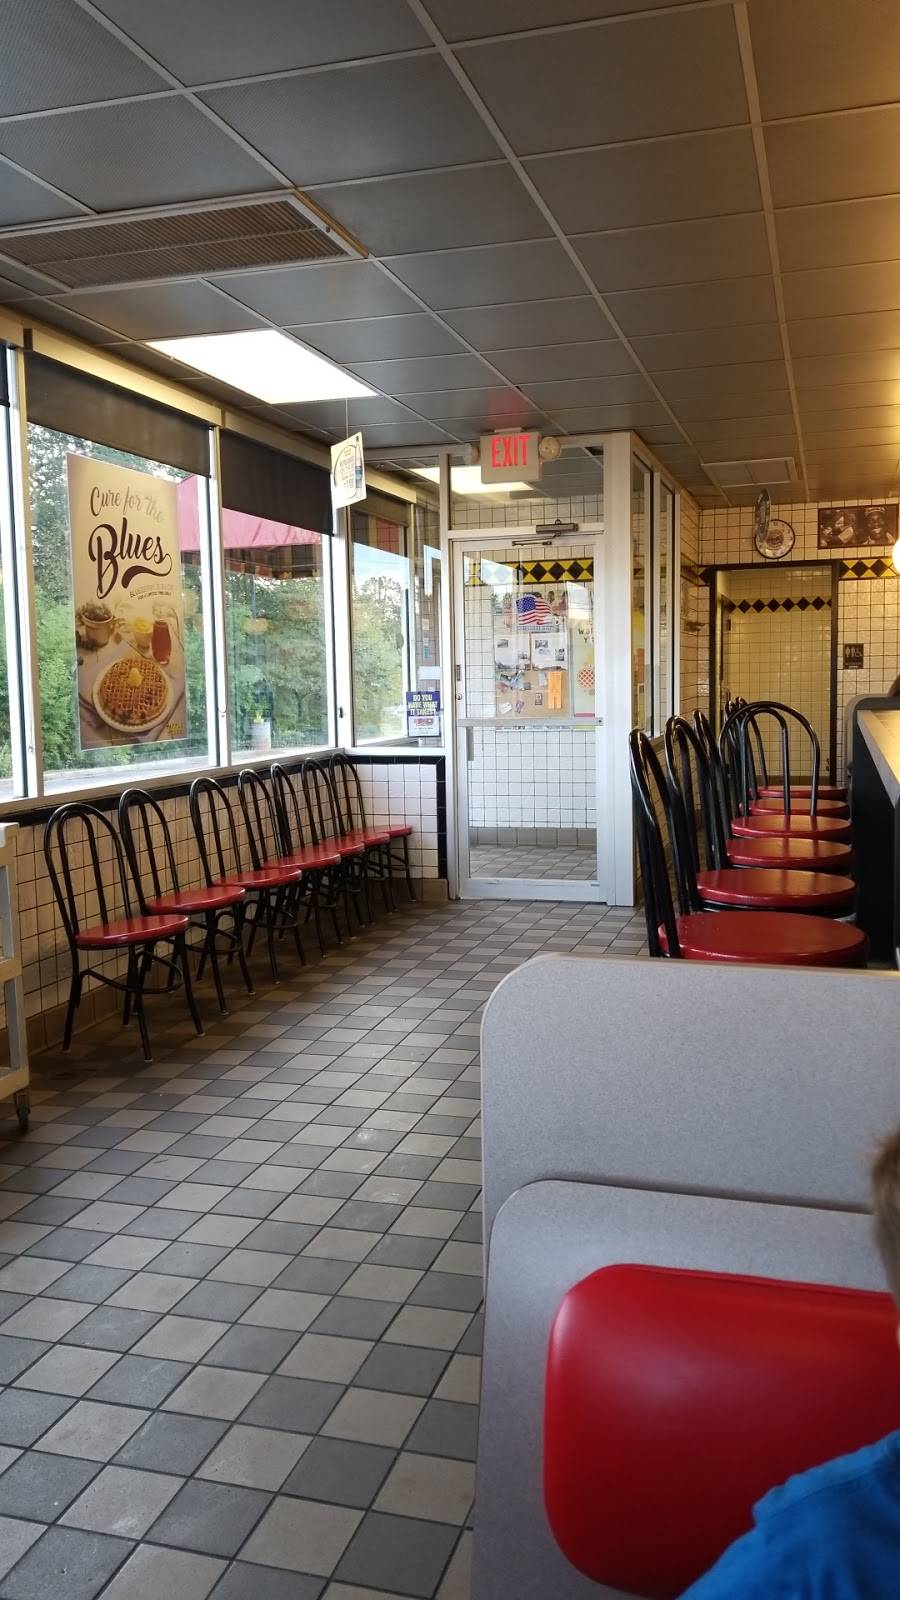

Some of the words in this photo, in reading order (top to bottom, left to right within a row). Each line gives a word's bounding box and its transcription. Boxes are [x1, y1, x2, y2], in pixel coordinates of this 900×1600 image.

[491, 435, 529, 468] EXIT
[90, 486, 121, 517] Cure
[122, 485, 141, 515] for
[145, 494, 164, 522] the
[88, 517, 172, 599] Blues
